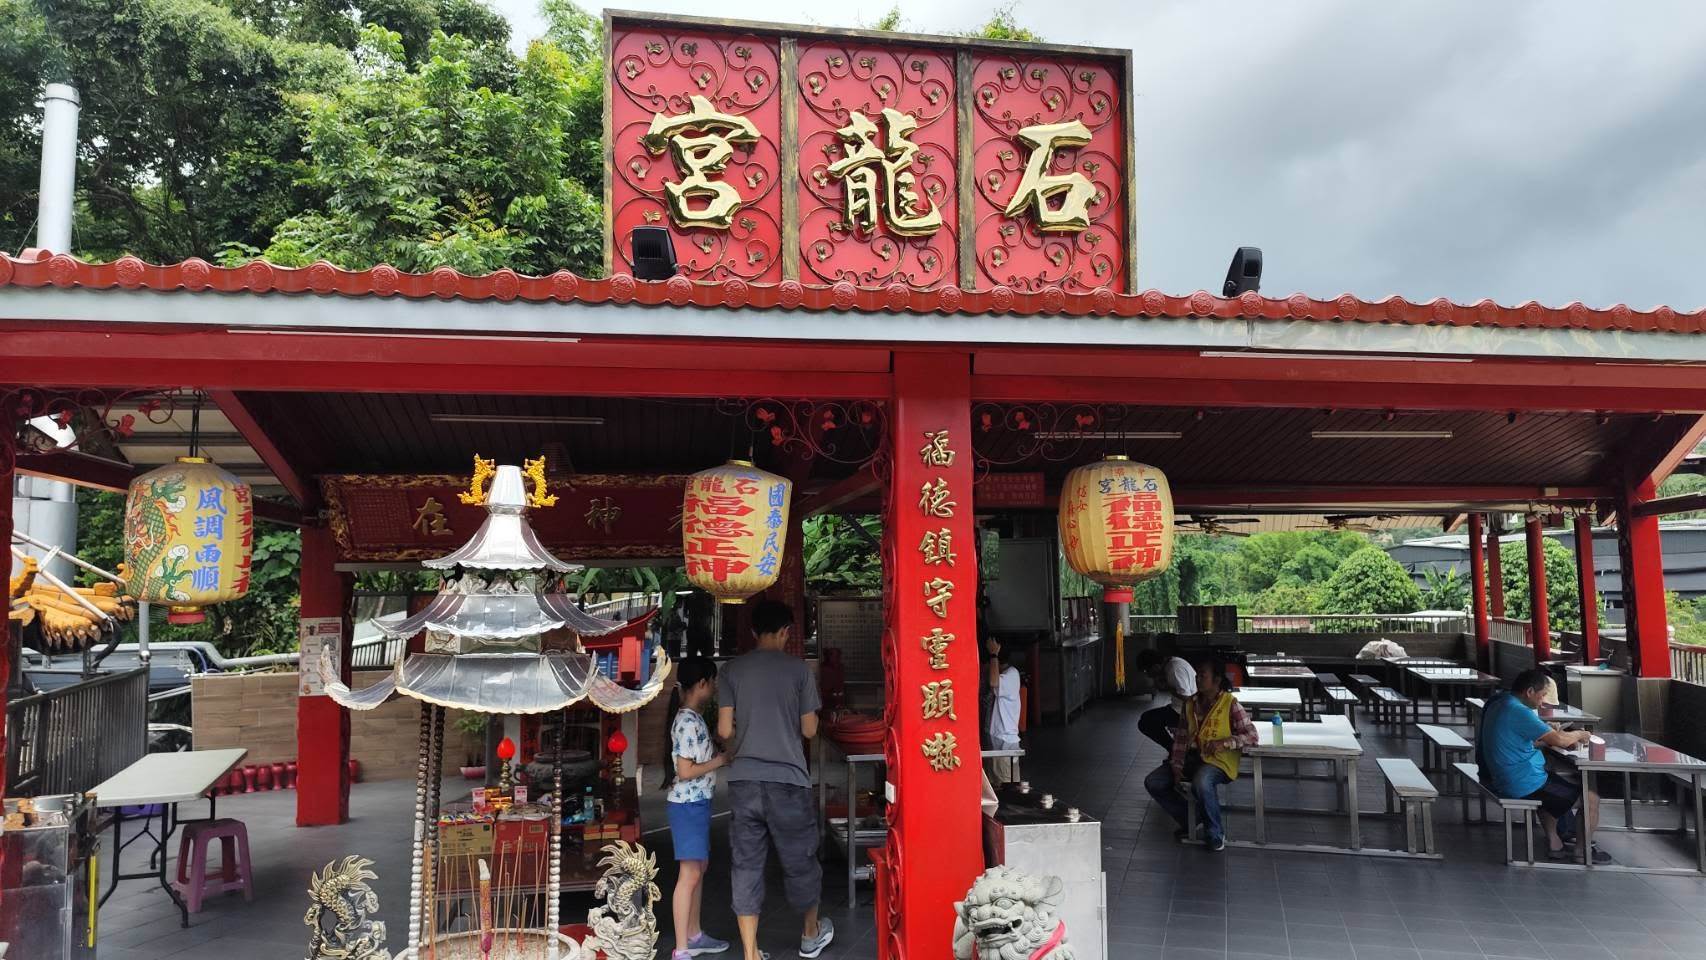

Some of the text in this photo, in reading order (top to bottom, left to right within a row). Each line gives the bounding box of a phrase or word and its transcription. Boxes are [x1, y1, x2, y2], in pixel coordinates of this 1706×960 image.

[755, 482, 786, 577] 國泰民安
[1098, 477, 1158, 494] 石龍宮
[1102, 491, 1164, 570] 福德正神
[192, 486, 227, 593] 風調雨順
[685, 493, 755, 583] 福德正神
